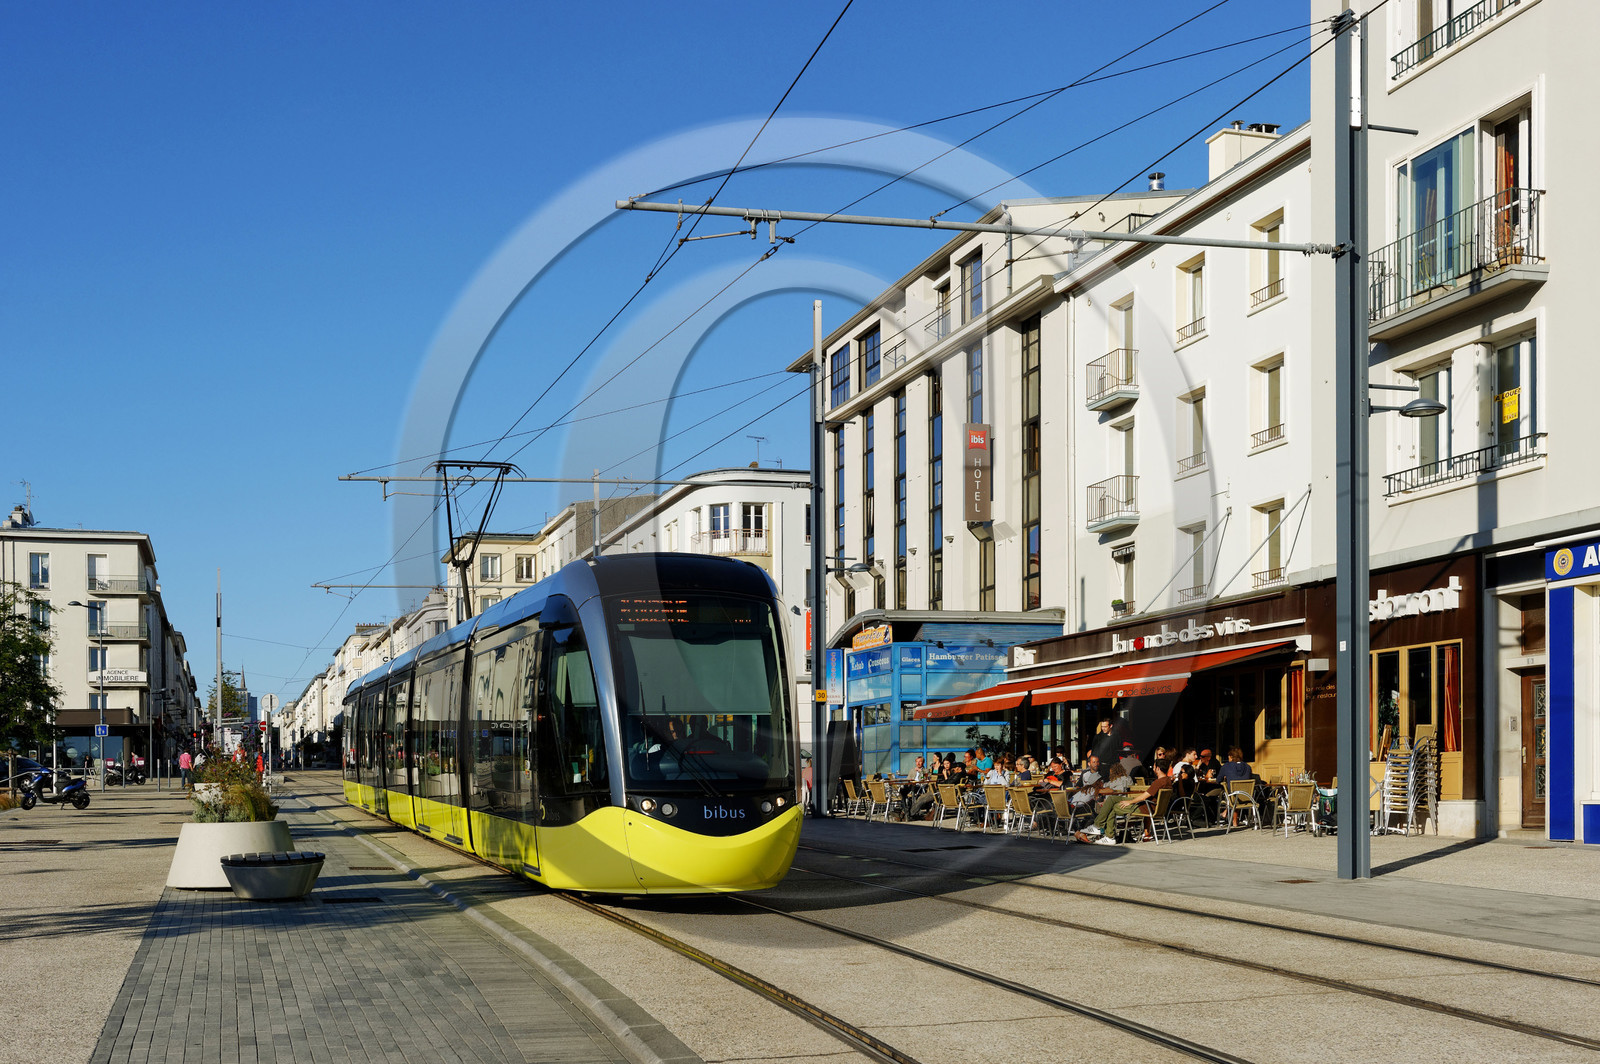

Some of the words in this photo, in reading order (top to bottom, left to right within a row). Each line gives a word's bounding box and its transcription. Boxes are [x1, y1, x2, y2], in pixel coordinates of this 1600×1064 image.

[1502, 387, 1521, 400] LOUER
[970, 435, 984, 444] ibis
[974, 458, 982, 513] HOTEL
[1582, 544, 1600, 568] A
[1369, 576, 1463, 622] staurant
[1179, 618, 1214, 643] des
[1215, 616, 1251, 636] vins
[851, 661, 865, 671] Kebab
[868, 657, 890, 673] Couscous
[929, 653, 972, 662] Hamburger
[1105, 688, 1114, 697] la
[1115, 685, 1139, 697] ronde
[1140, 683, 1155, 694] des
[1156, 684, 1172, 693] vins
[704, 805, 746, 819] bibus
